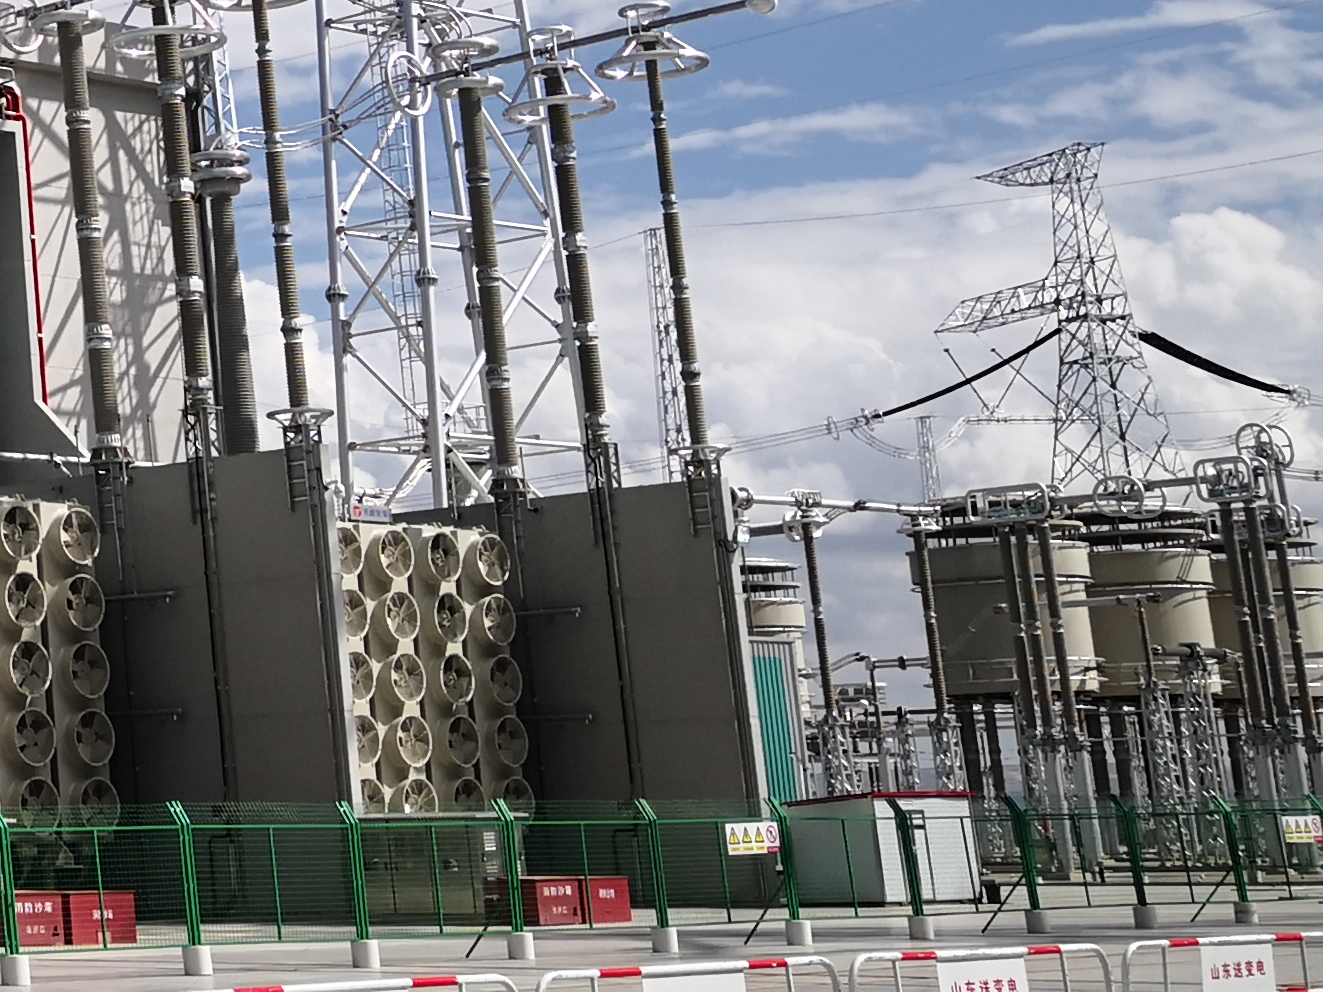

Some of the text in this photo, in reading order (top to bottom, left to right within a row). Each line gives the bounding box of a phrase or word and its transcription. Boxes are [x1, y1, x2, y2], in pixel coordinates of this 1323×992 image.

[1211, 958, 1266, 980] 山东送变电
